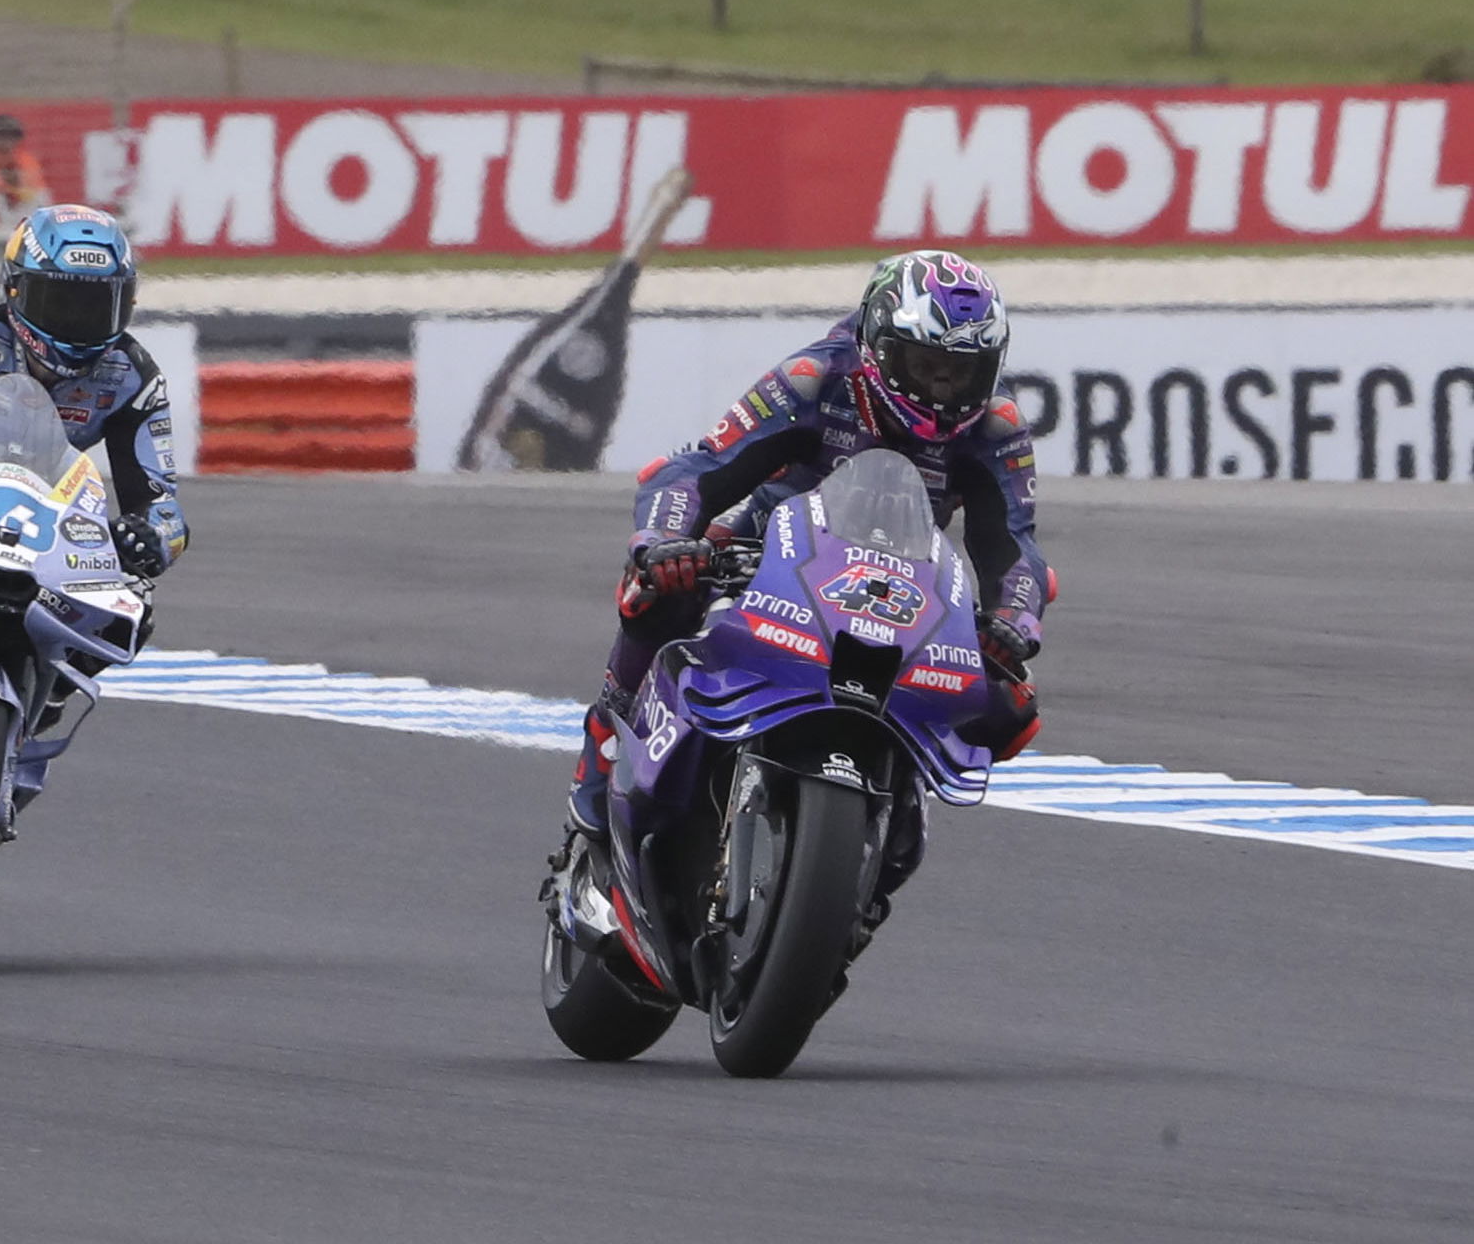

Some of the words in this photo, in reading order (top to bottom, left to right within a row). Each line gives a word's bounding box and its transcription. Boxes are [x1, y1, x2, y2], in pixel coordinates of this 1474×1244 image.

[129, 108, 713, 250] MOTUL
[873, 98, 1471, 240] MOTUL
[69, 250, 107, 265] SHOEI
[809, 494, 827, 527] WRS
[775, 504, 796, 560] PRAMAC
[844, 546, 915, 579] prima
[37, 587, 71, 615] BOLD
[740, 590, 813, 625] prima
[816, 562, 927, 629] 43
[755, 623, 821, 657] MOTUL
[850, 616, 895, 643] FIAMM
[925, 643, 982, 668] prima
[910, 668, 964, 691] MOTUL
